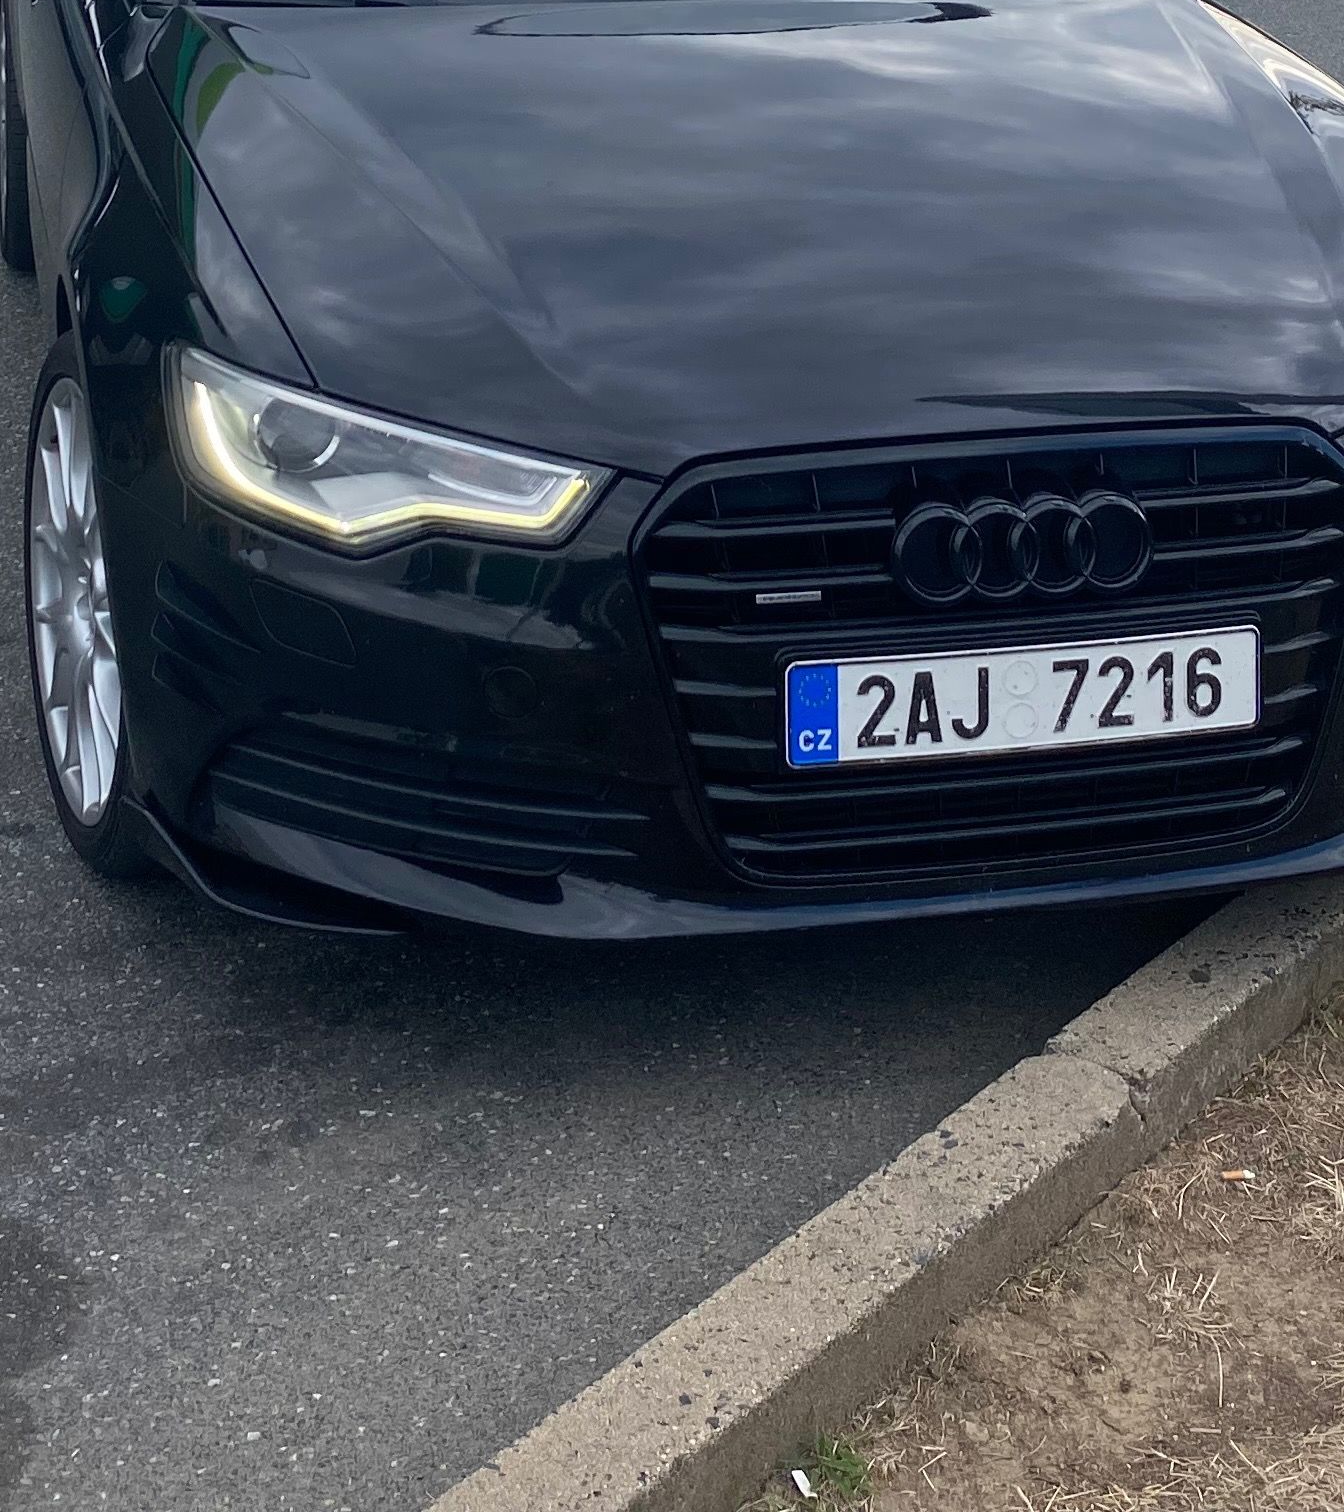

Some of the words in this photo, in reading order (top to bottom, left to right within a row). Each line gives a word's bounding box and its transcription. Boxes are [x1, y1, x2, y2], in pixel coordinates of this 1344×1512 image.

[857, 666, 991, 749] 2AJ
[1052, 646, 1224, 734] 7216
[798, 728, 833, 753] CZ
